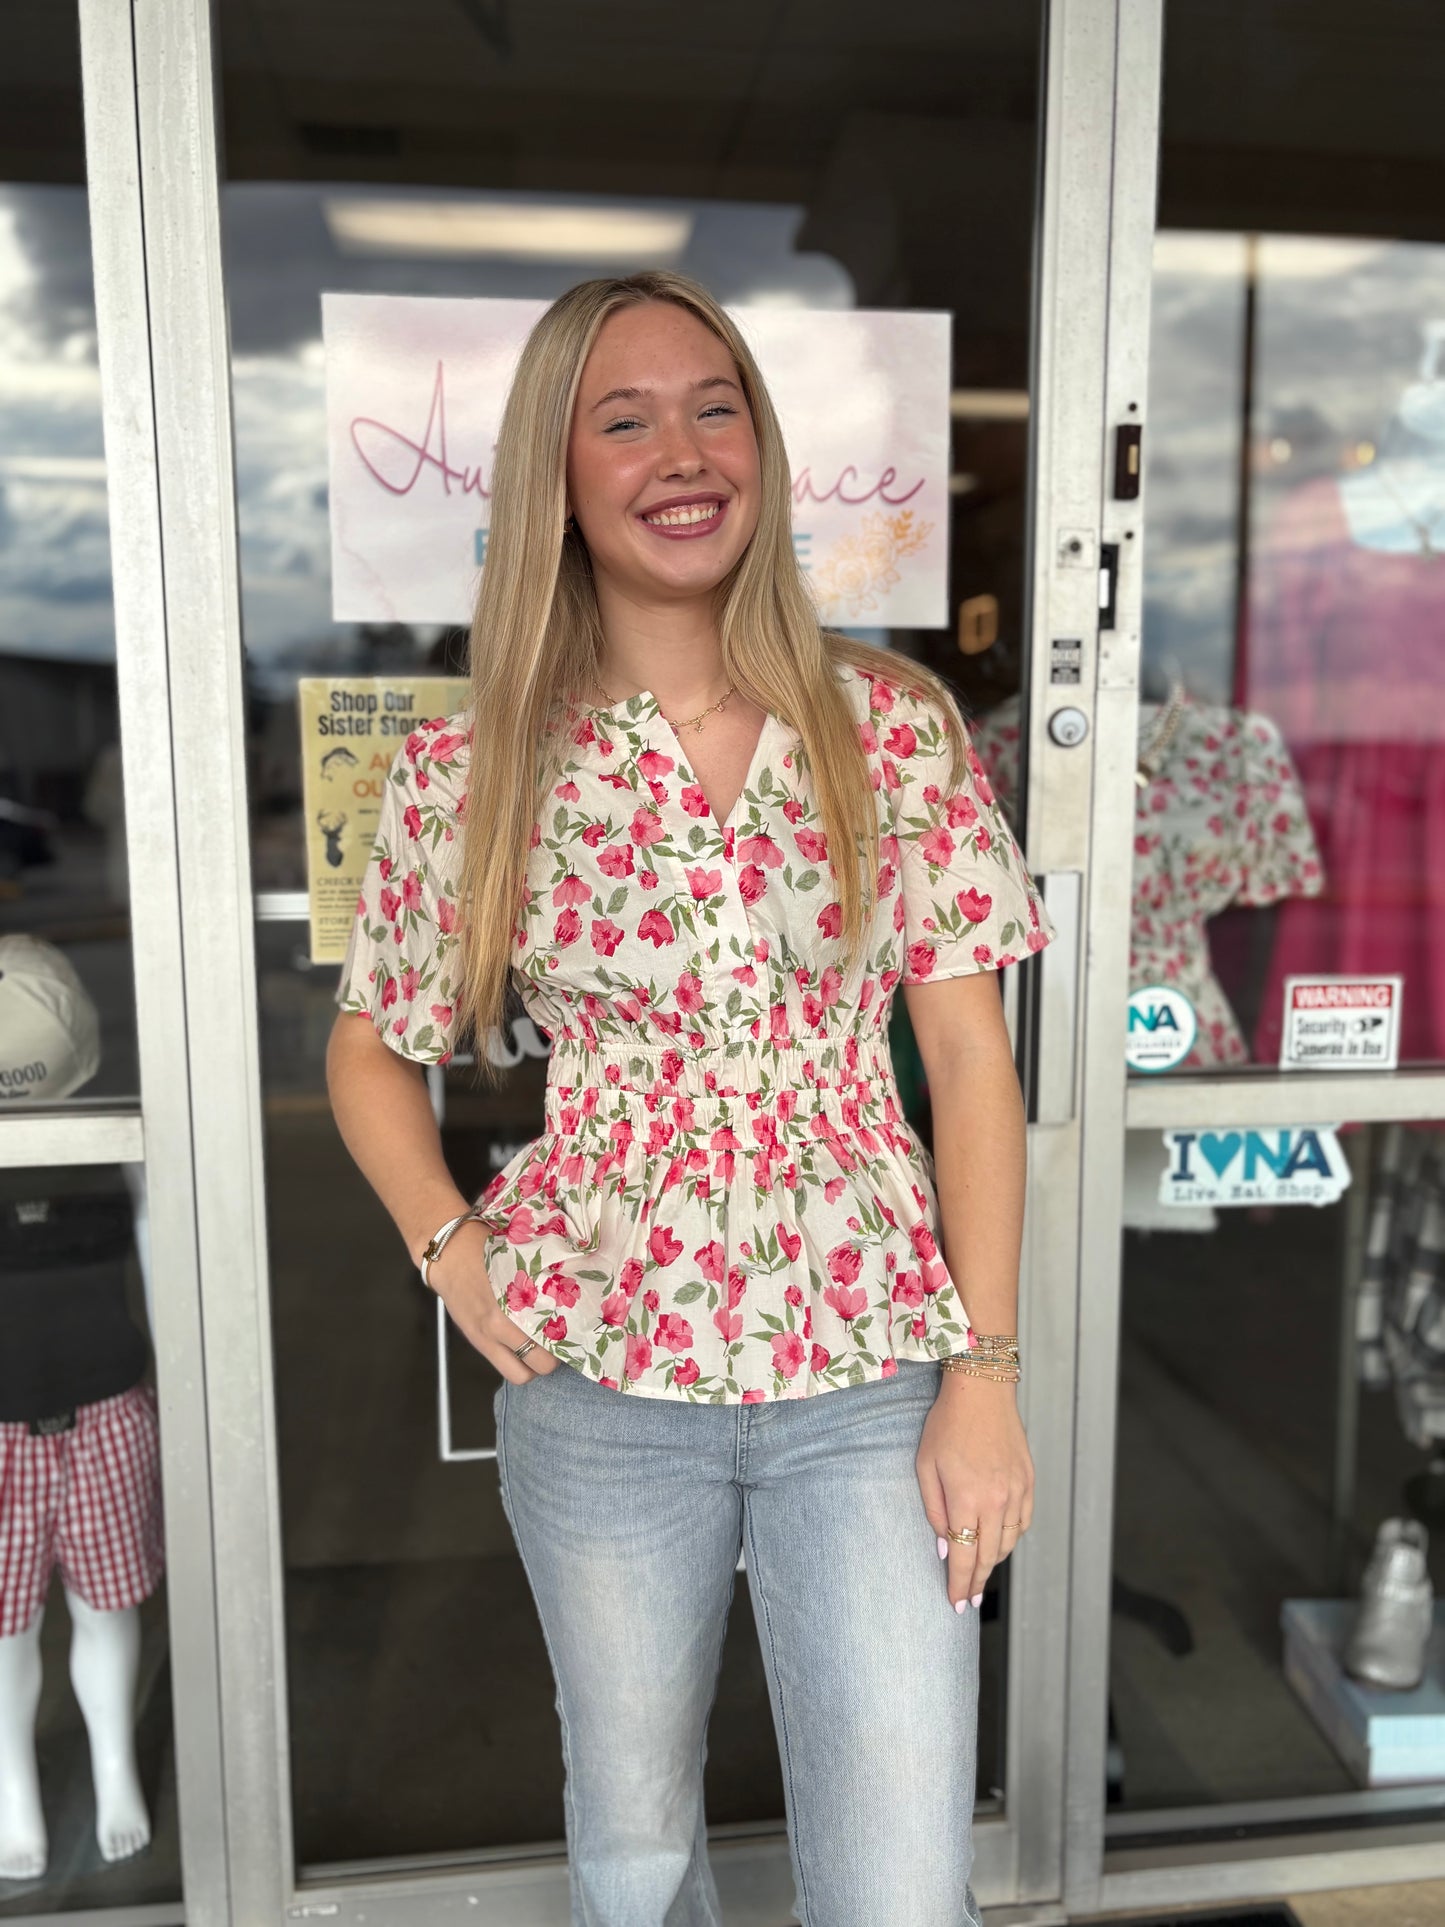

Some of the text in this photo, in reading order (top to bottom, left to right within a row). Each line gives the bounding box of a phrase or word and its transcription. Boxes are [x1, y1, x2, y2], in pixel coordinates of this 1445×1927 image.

[793, 464, 926, 505] ace
[330, 691, 414, 715] Shop Our
[318, 714, 374, 736] Sister
[353, 779, 384, 798] OU
[1295, 986, 1390, 1007] WARNING
[1128, 1004, 1179, 1032] NA
[1297, 1017, 1346, 1038] Security
[1172, 1129, 1334, 1181] I NA
